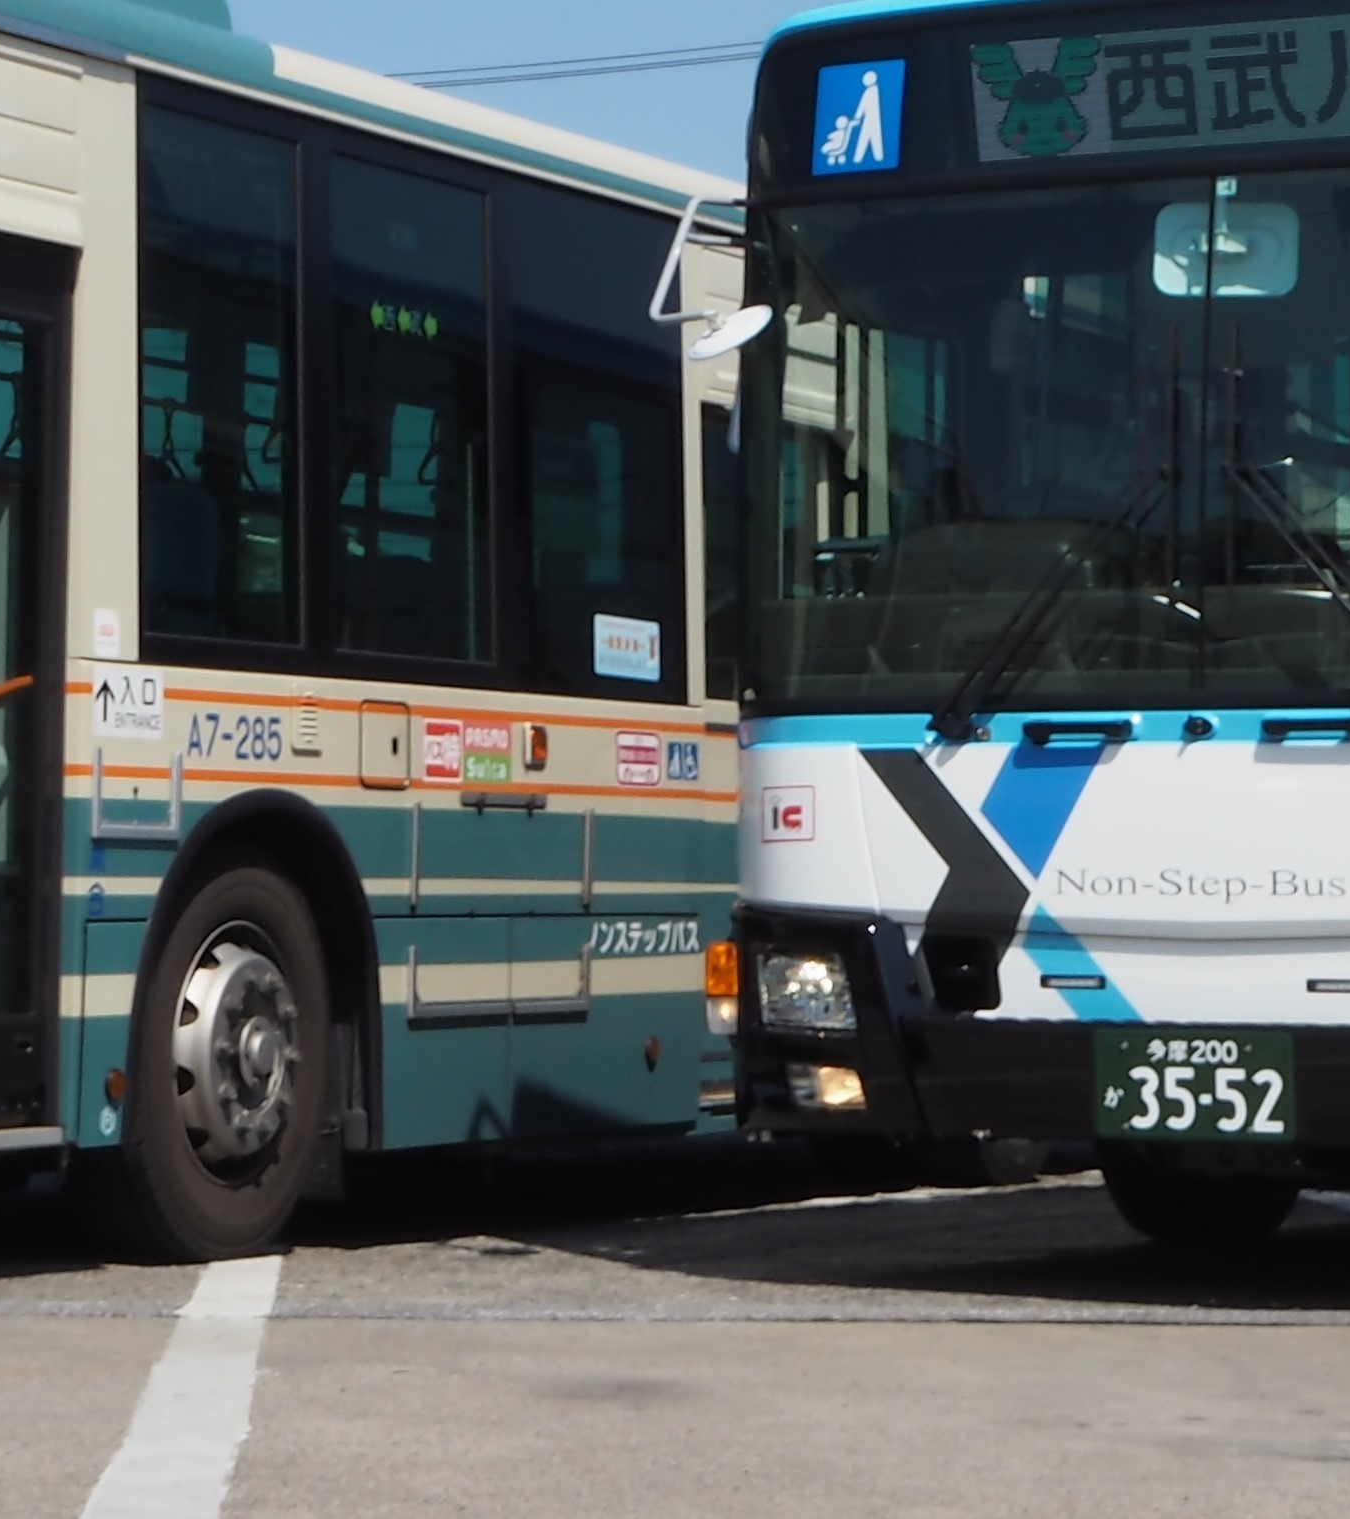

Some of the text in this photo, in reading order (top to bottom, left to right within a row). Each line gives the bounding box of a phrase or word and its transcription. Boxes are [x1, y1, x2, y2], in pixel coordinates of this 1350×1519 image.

[120, 675, 157, 706] 入口
[186, 712, 284, 762] A7-285
[589, 919, 701, 954] ノンステップバス
[1128, 1065, 1286, 1134] 35-52
